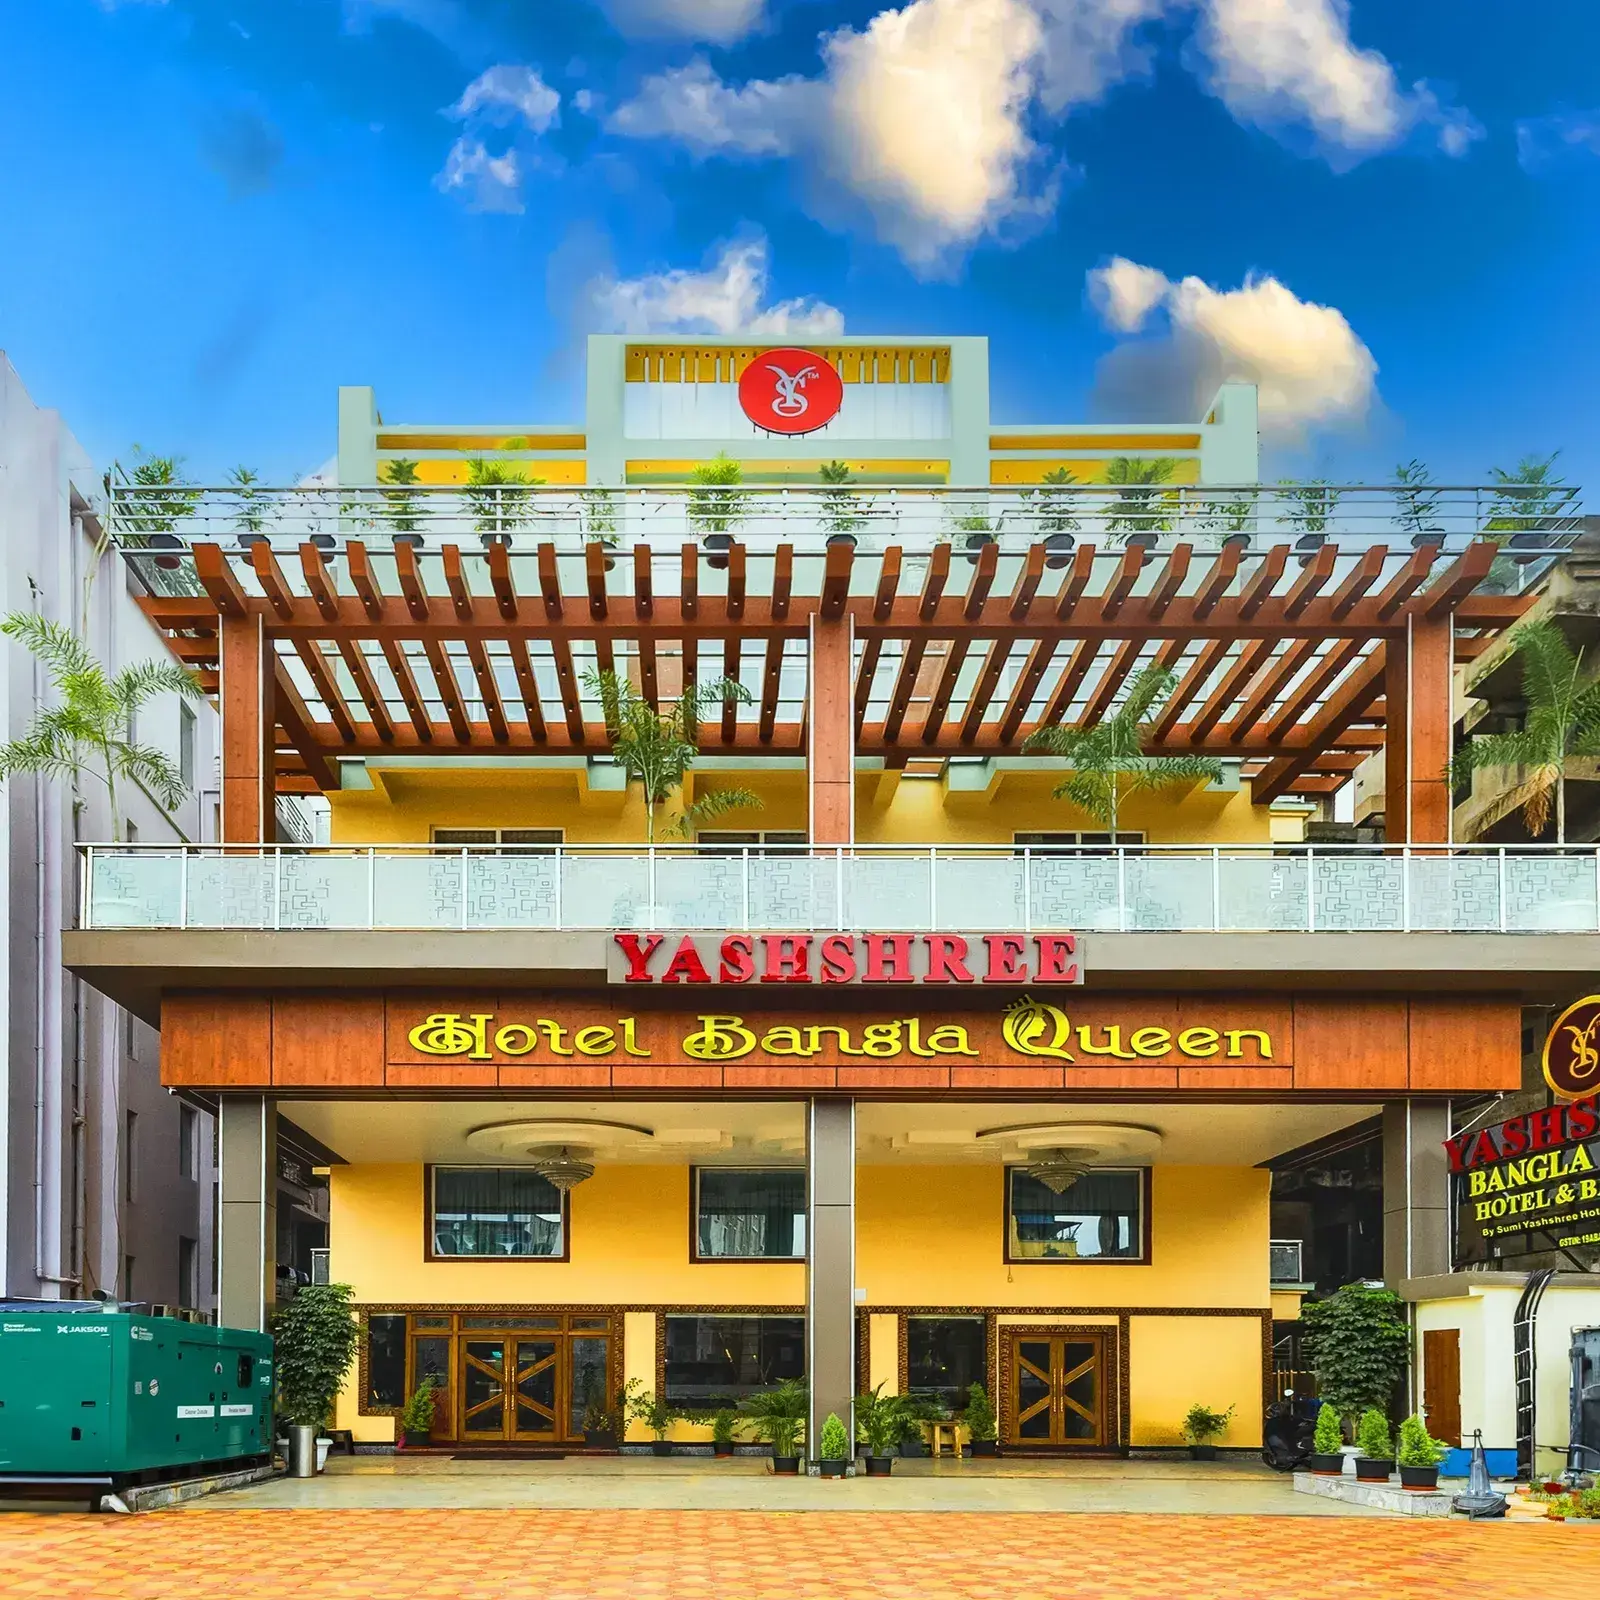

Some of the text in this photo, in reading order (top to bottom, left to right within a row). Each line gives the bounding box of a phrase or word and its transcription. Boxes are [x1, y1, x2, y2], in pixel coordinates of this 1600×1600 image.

[613, 934, 1078, 983] YASHSHREE
[408, 993, 1273, 1062] Hotel Bangla Queen
[1442, 1097, 1600, 1174] YASHS
[1468, 1144, 1594, 1198] BANGLA
[1475, 1179, 1600, 1221] HOTEL & B
[1482, 1228, 1495, 1237] By
[1497, 1223, 1522, 1235] Sumi
[1523, 1213, 1579, 1229] Yashshree
[1582, 1232, 1600, 1244] 19AB
